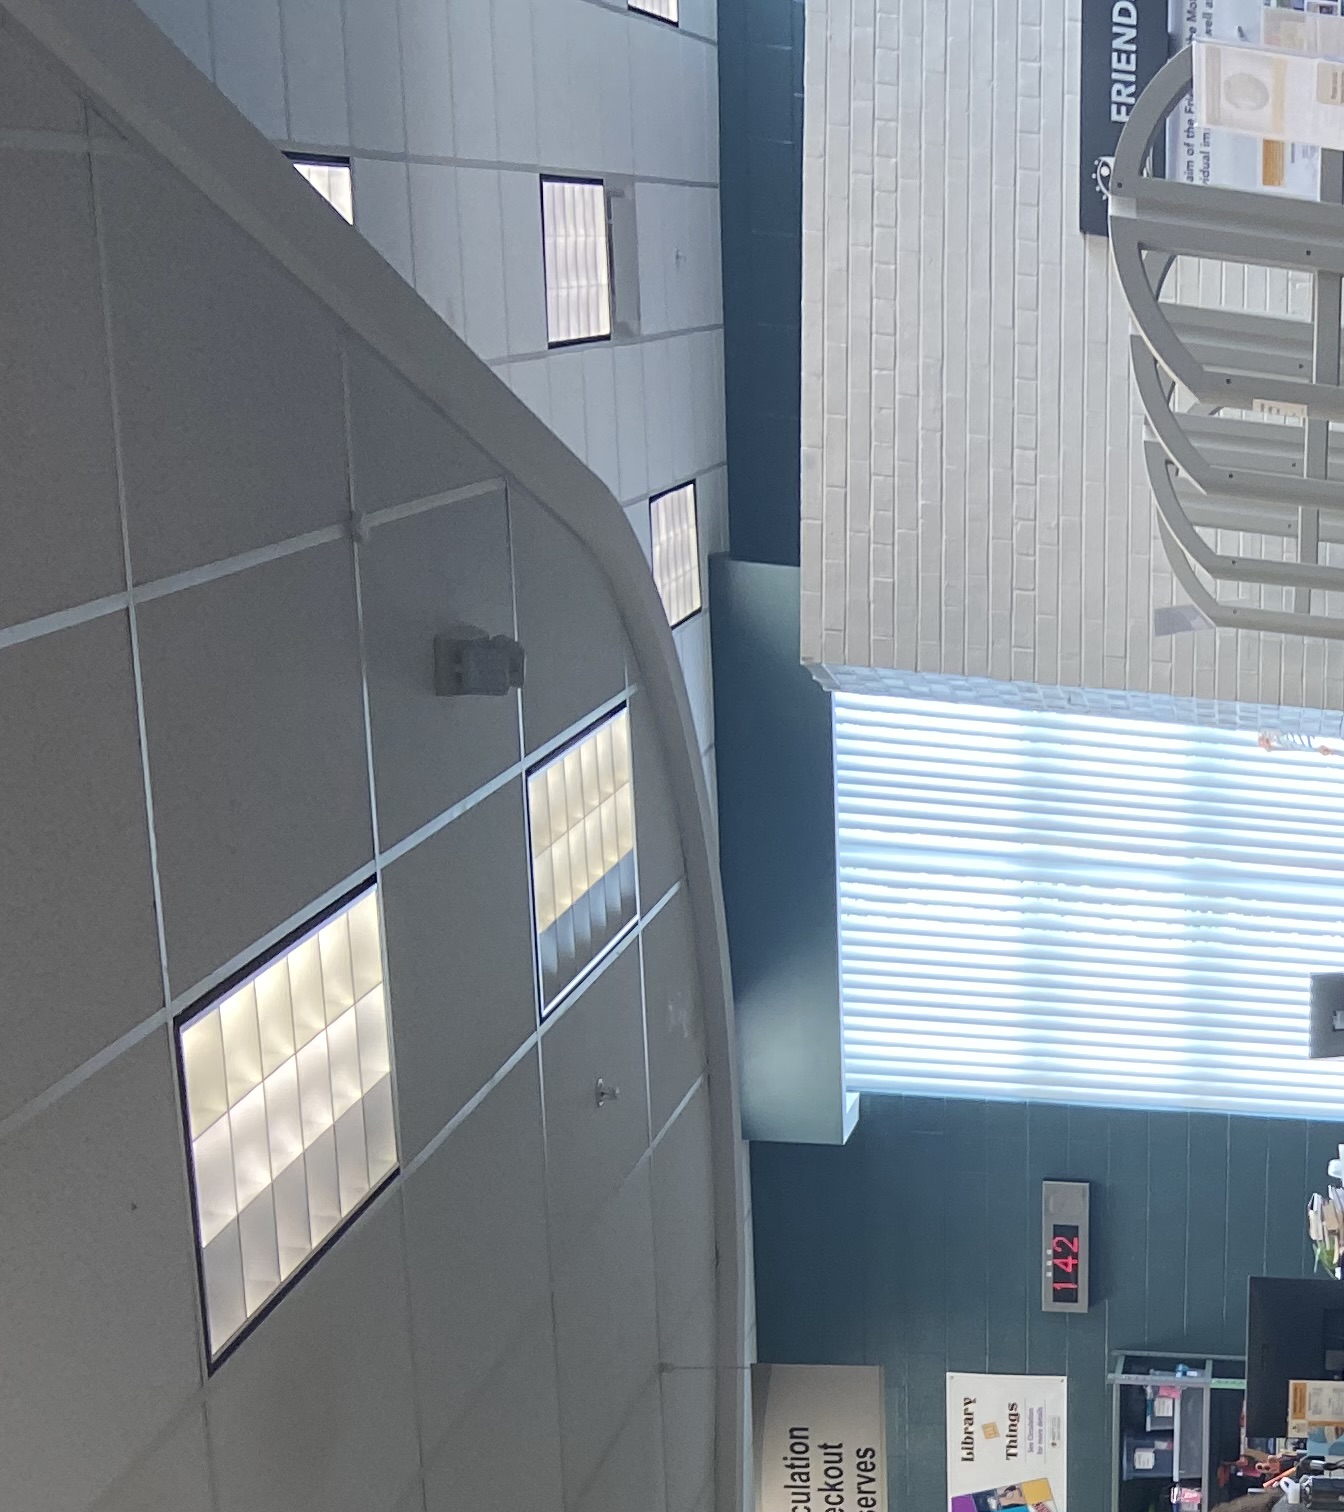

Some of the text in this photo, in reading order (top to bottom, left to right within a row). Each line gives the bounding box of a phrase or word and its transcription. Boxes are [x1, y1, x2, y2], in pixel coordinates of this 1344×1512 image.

[1110, 0, 1138, 122] FRIEND
[1183, 118, 1196, 138] the
[1182, 142, 1195, 156] of
[1184, 160, 1195, 182] aim
[960, 1396, 976, 1462] Library
[1005, 1401, 1020, 1460] Things
